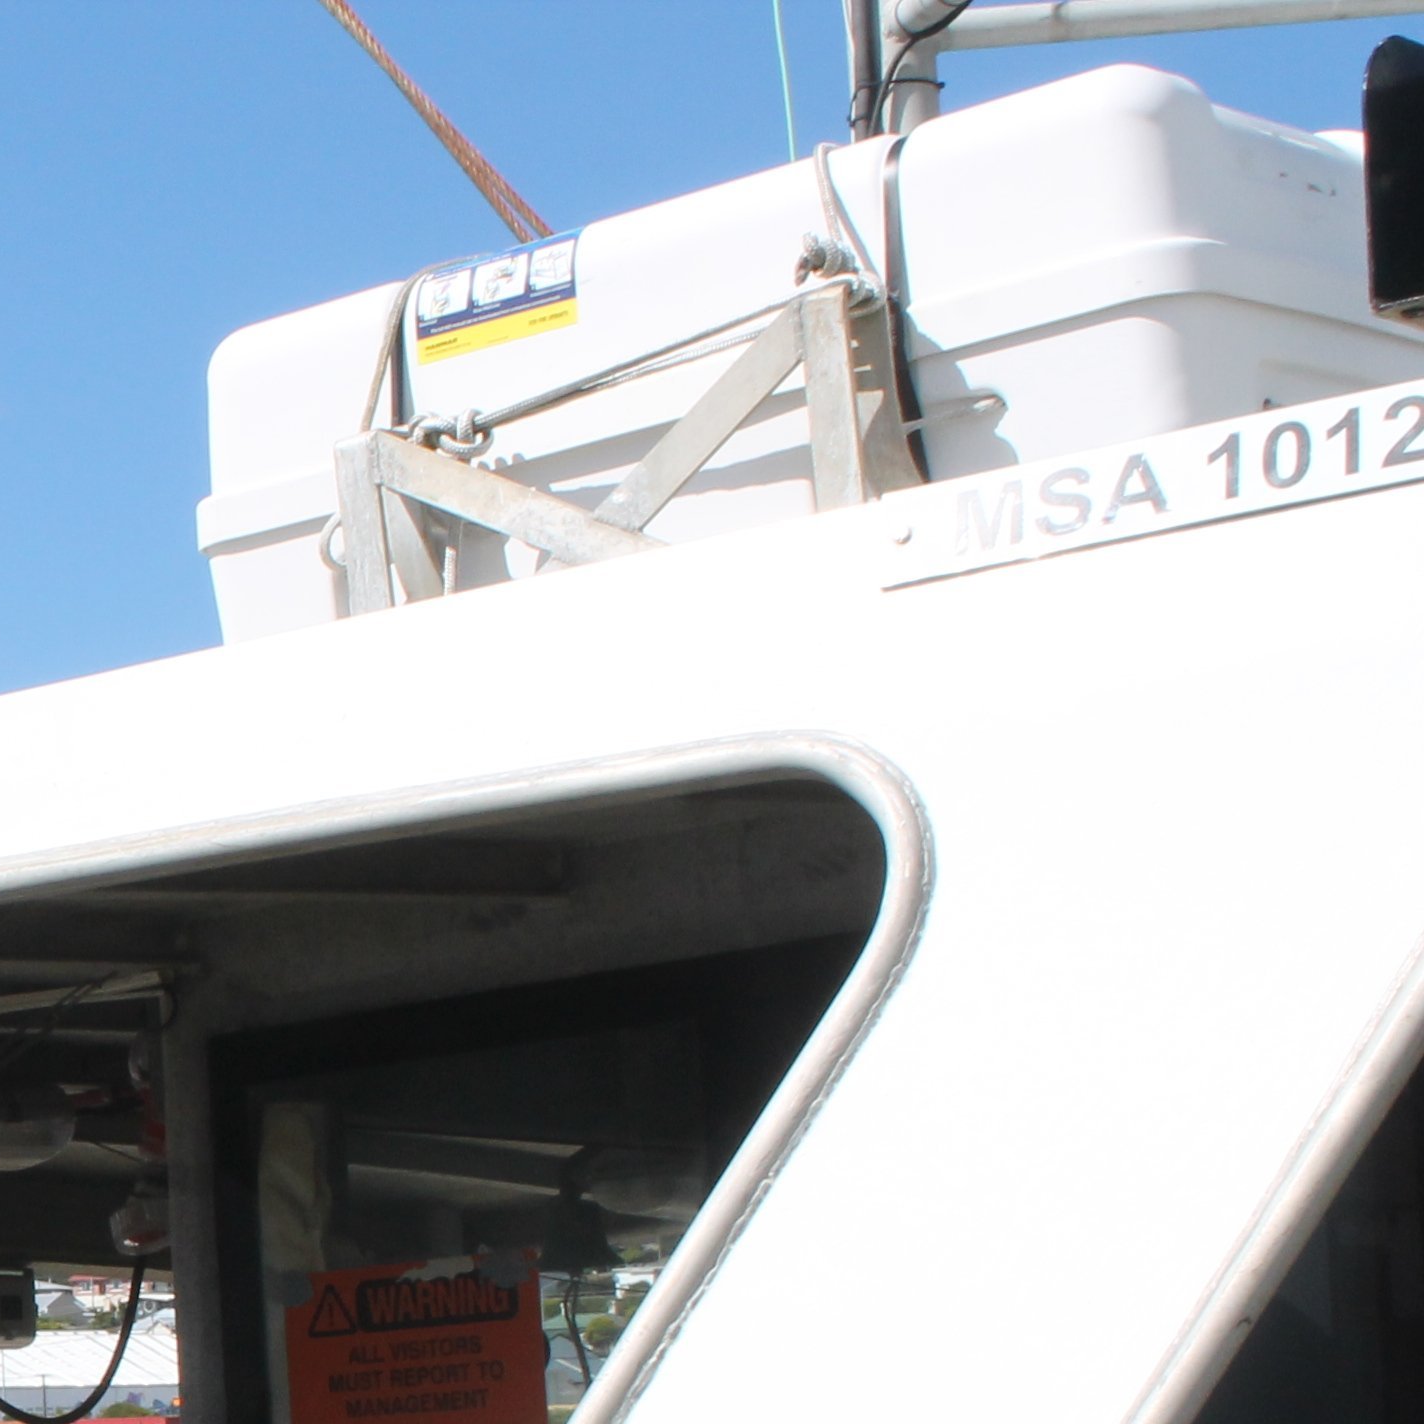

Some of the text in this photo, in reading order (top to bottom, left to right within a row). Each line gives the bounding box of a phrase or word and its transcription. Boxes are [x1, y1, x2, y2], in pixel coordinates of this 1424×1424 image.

[953, 394, 1424, 556] MSA 1012
[366, 1277, 511, 1325] WARNING
[349, 1335, 482, 1364] ALL VISITORS
[329, 1360, 506, 1393] MUST REPORT TO
[345, 1388, 489, 1418] MANAGEMENT
